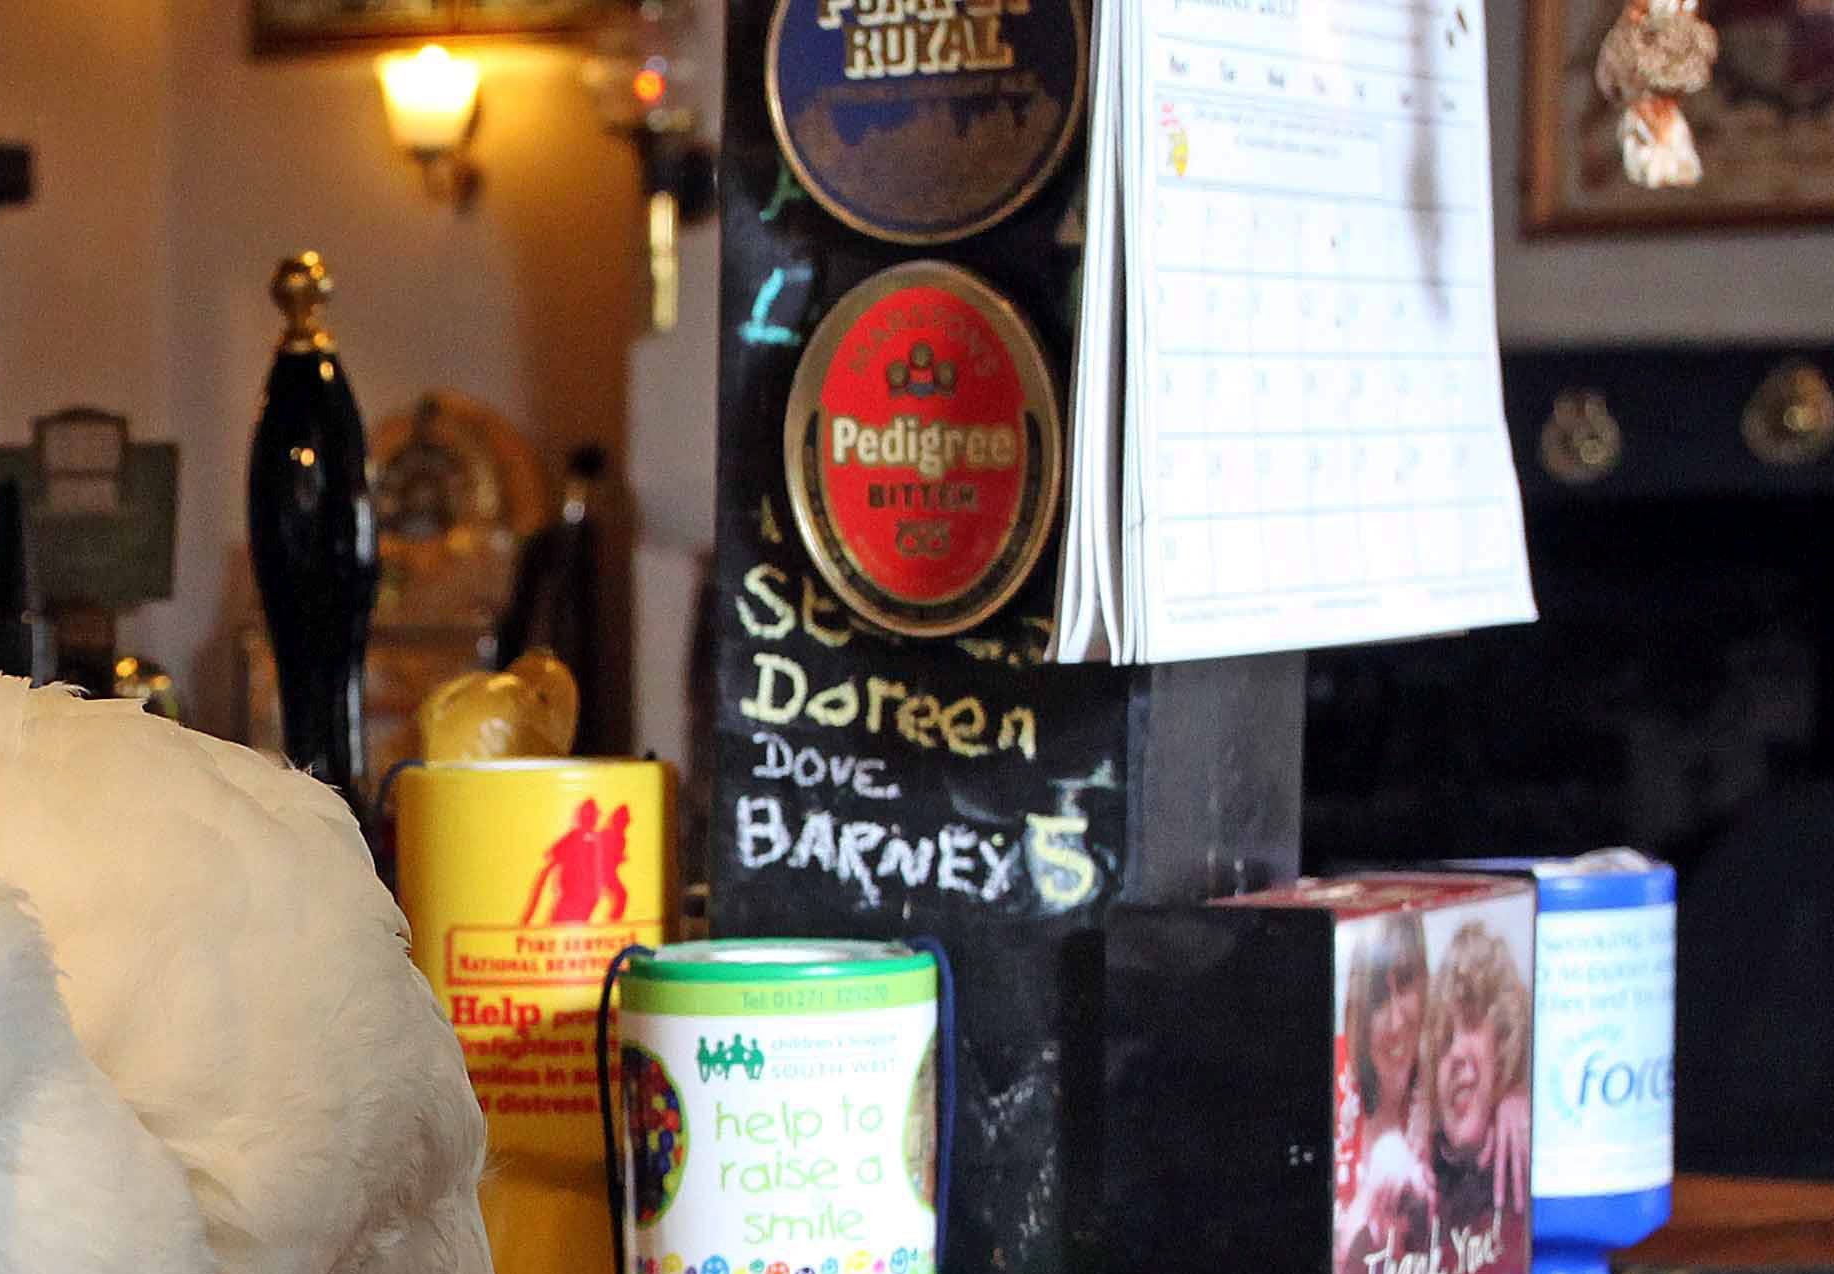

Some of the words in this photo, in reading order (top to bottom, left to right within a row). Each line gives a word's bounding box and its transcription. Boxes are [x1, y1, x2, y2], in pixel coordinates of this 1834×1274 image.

[831, 414, 1015, 480] Pedigree
[868, 483, 978, 512] BITTER
[740, 652, 1037, 761] Doreen
[735, 795, 1017, 908] BARNEY
[450, 995, 542, 1038] Help
[715, 1100, 822, 1150] help
[840, 1094, 885, 1135] to
[718, 1151, 840, 1194] raise
[854, 1153, 885, 1186] a
[742, 1200, 867, 1246] smile
